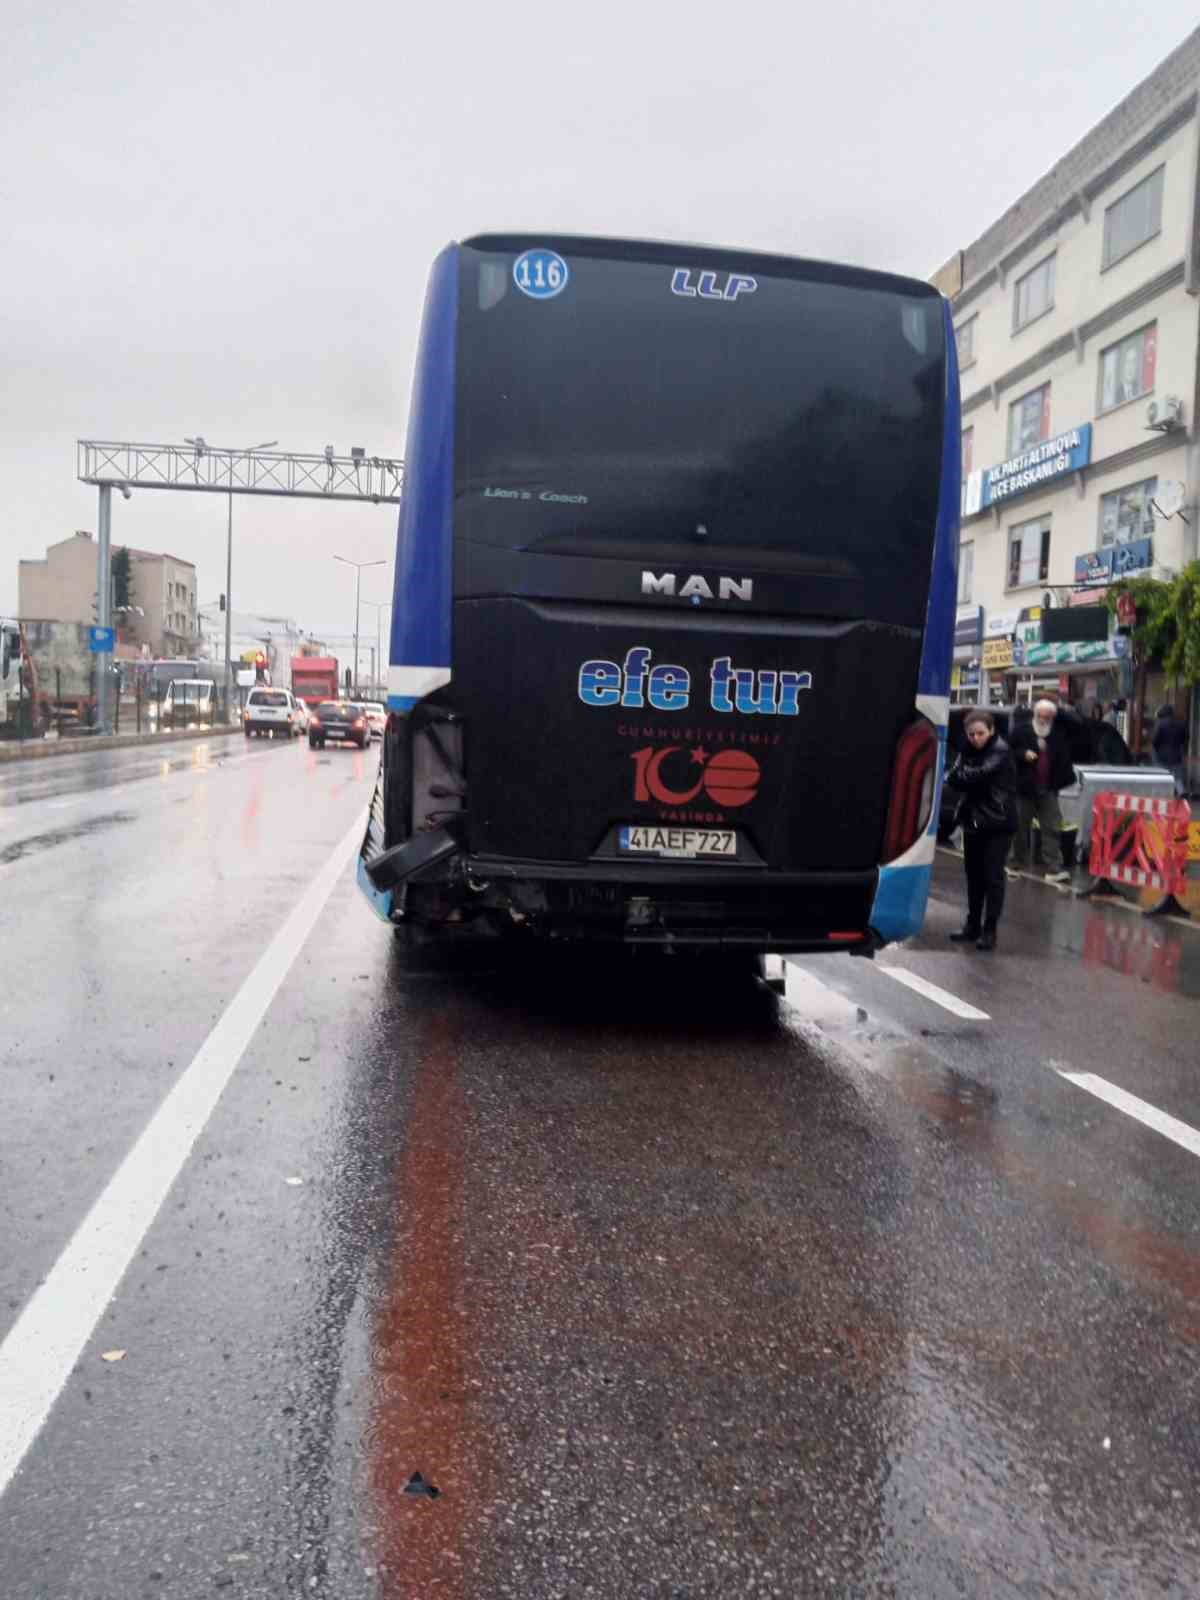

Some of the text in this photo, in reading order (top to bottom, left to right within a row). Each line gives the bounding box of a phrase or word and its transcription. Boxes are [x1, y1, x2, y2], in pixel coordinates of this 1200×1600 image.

[519, 260, 562, 287] 116
[671, 268, 758, 301] LLP
[538, 490, 589, 505] Coach
[641, 570, 753, 601] MAN
[578, 646, 812, 716] efe tur
